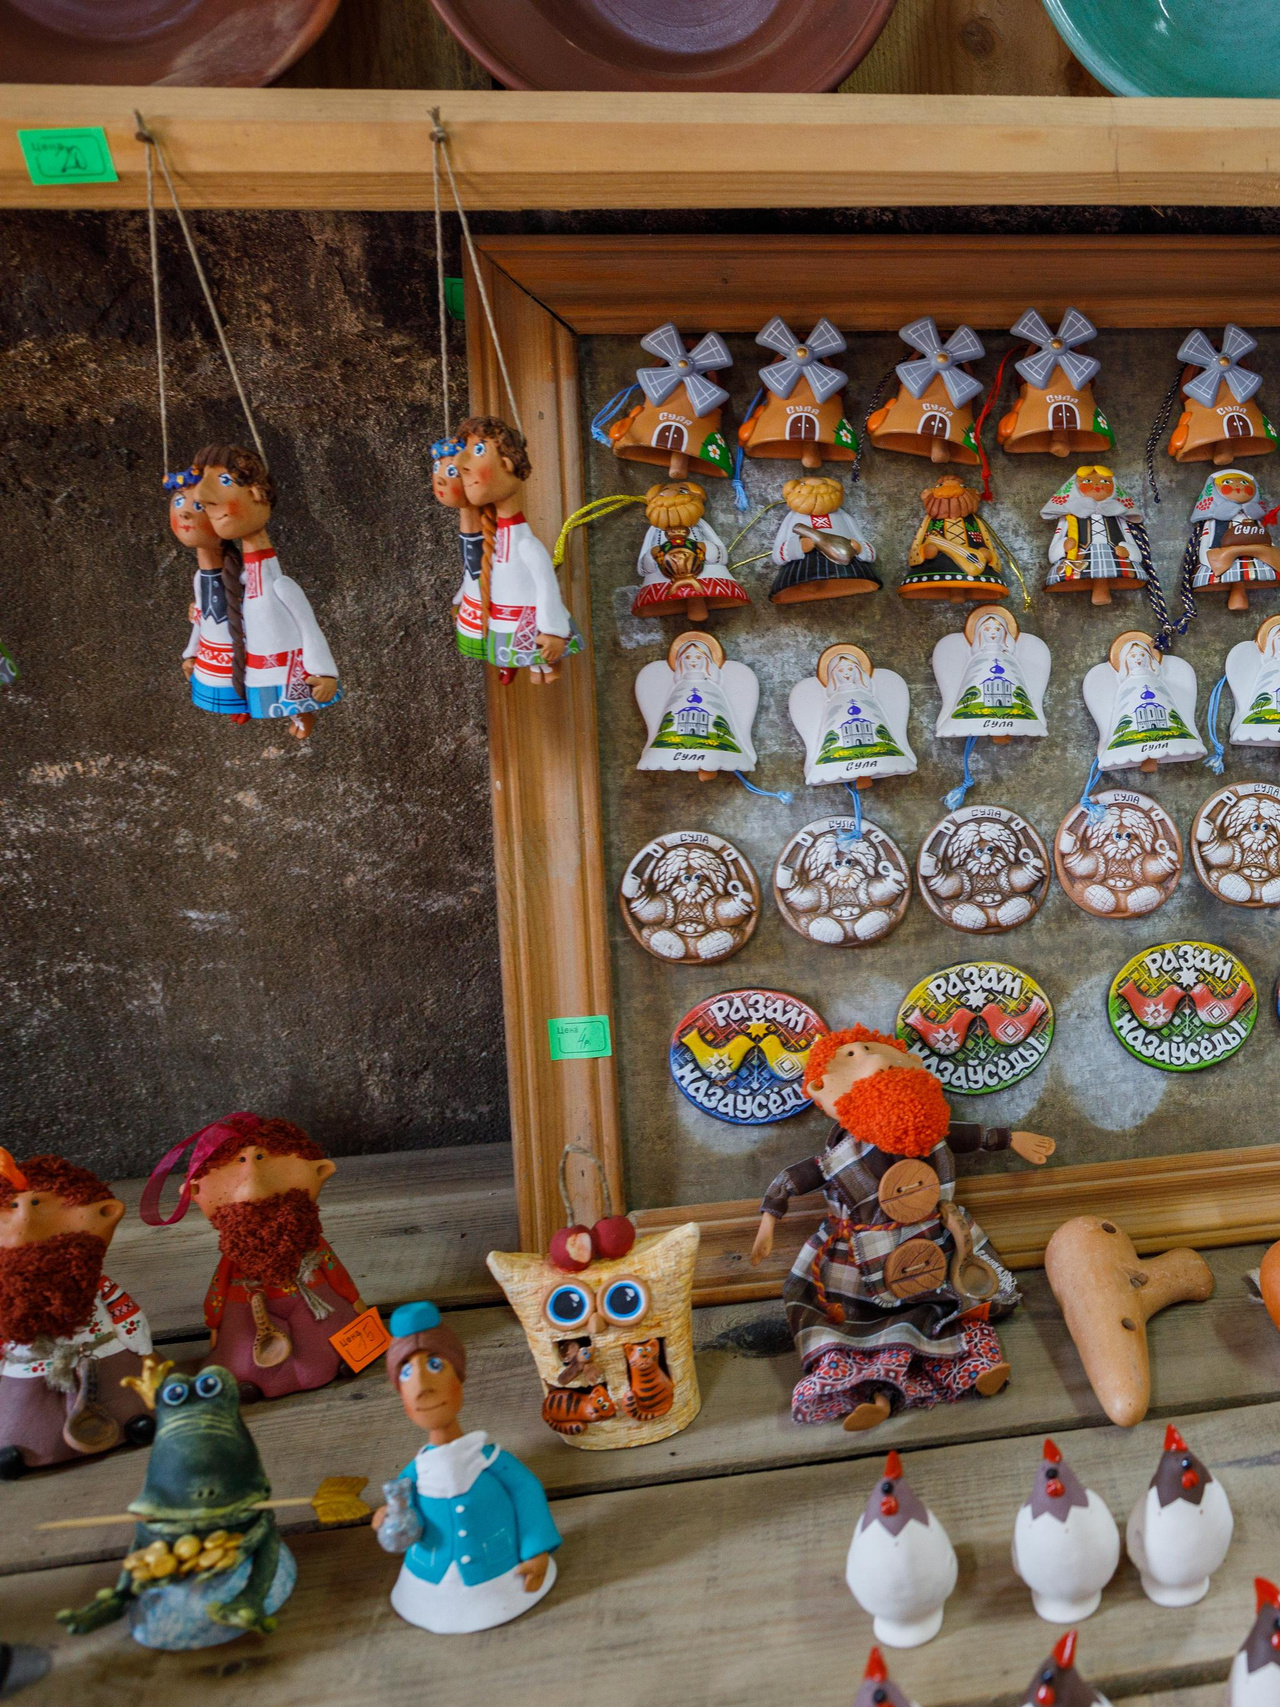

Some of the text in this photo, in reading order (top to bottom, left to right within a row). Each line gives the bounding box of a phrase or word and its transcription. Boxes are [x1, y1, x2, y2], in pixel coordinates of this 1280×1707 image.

[1254, 784, 1280, 797] СУЛА
[1113, 793, 1140, 805] СУЛА
[971, 809, 1003, 818] СУЛА
[828, 819, 857, 830] СУЛА
[680, 833, 709, 845] СУЛА
[556, 1026, 579, 1034] Цена
[339, 1330, 362, 1347] Цена
